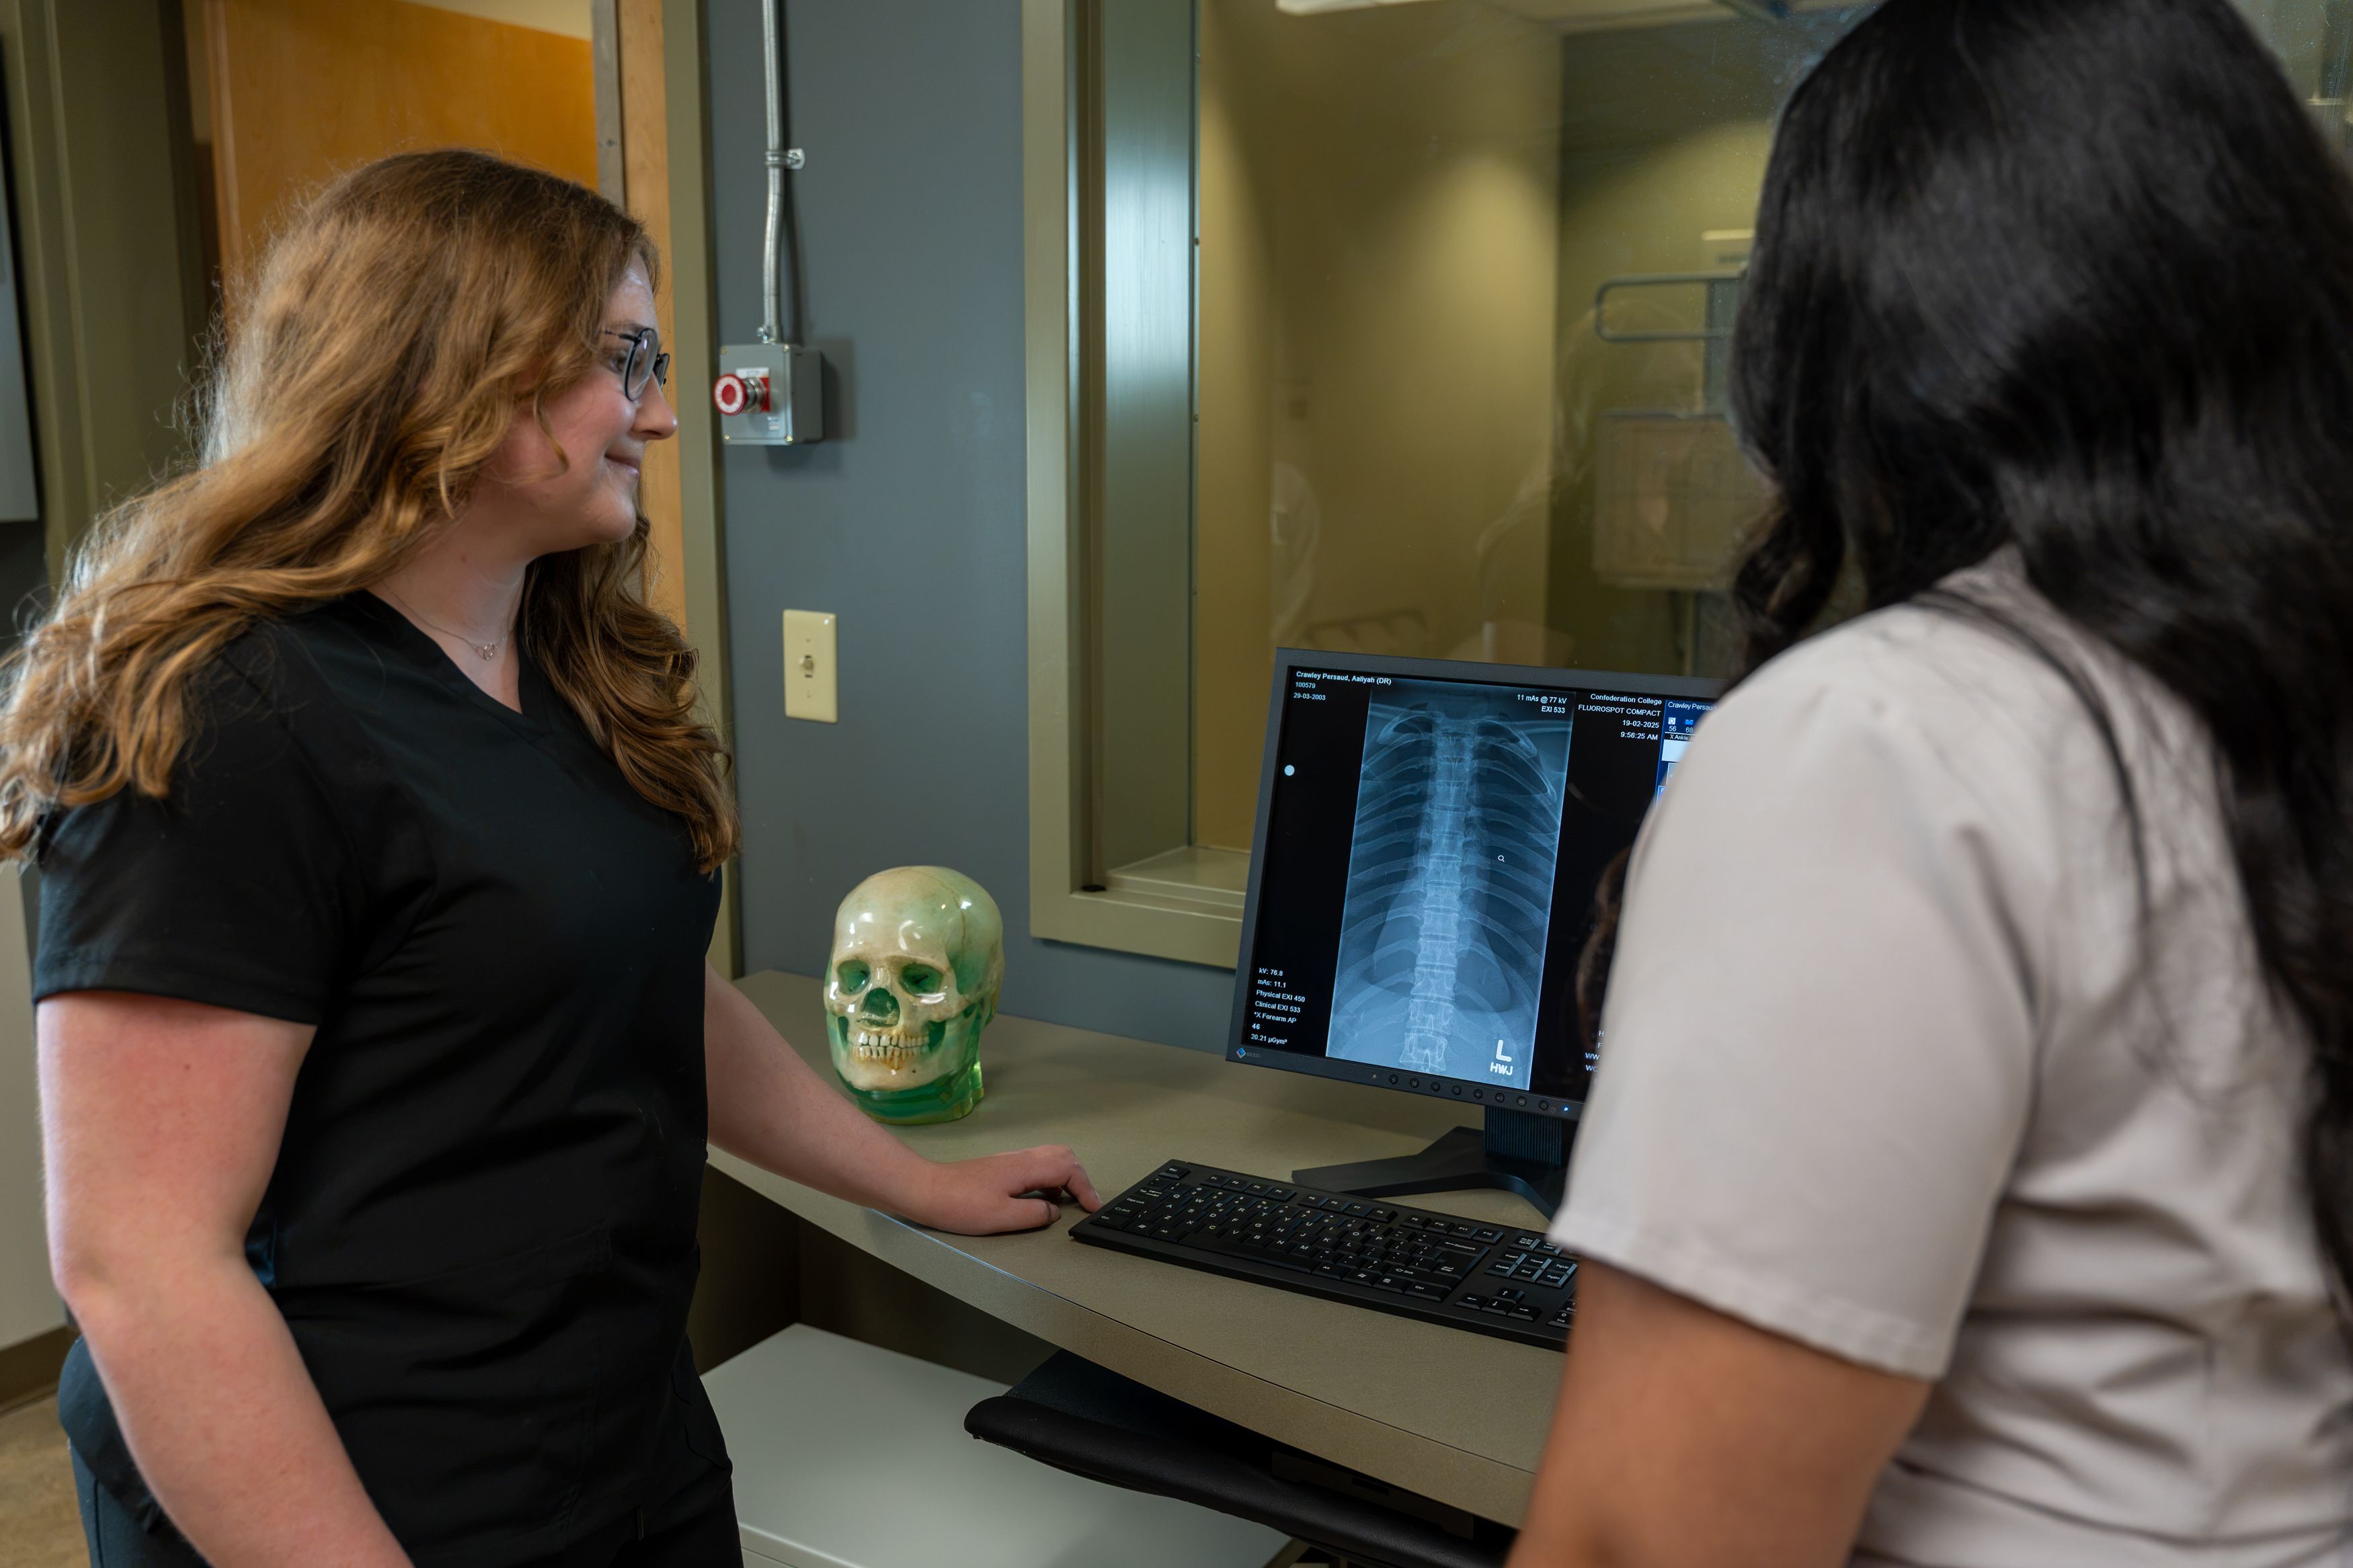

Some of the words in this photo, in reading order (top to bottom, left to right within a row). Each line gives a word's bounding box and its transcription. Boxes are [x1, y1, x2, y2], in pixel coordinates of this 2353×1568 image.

[1296, 671, 1321, 680] Crawley
[1322, 673, 1350, 682] Persaud,
[1352, 675, 1374, 684] Aaliyah
[1377, 677, 1392, 686] (DR)
[1293, 692, 1326, 700] 29-03-2003
[1591, 694, 1636, 703] Confederation
[1638, 698, 1662, 706] College
[1579, 704, 1624, 714] FLUOROSPOT
[1626, 708, 1661, 716] COMPACT
[1668, 701, 1691, 710] Crawley
[1622, 720, 1659, 729] 19-02-2025
[1257, 989, 1281, 999] Physical
[1255, 1001, 1276, 1009] Clinical
[1263, 1014, 1286, 1022] Forearm
[1251, 1034, 1267, 1042] 20.21
[1496, 1040, 1512, 1062] L
[1490, 1062, 1513, 1075] HWJ
